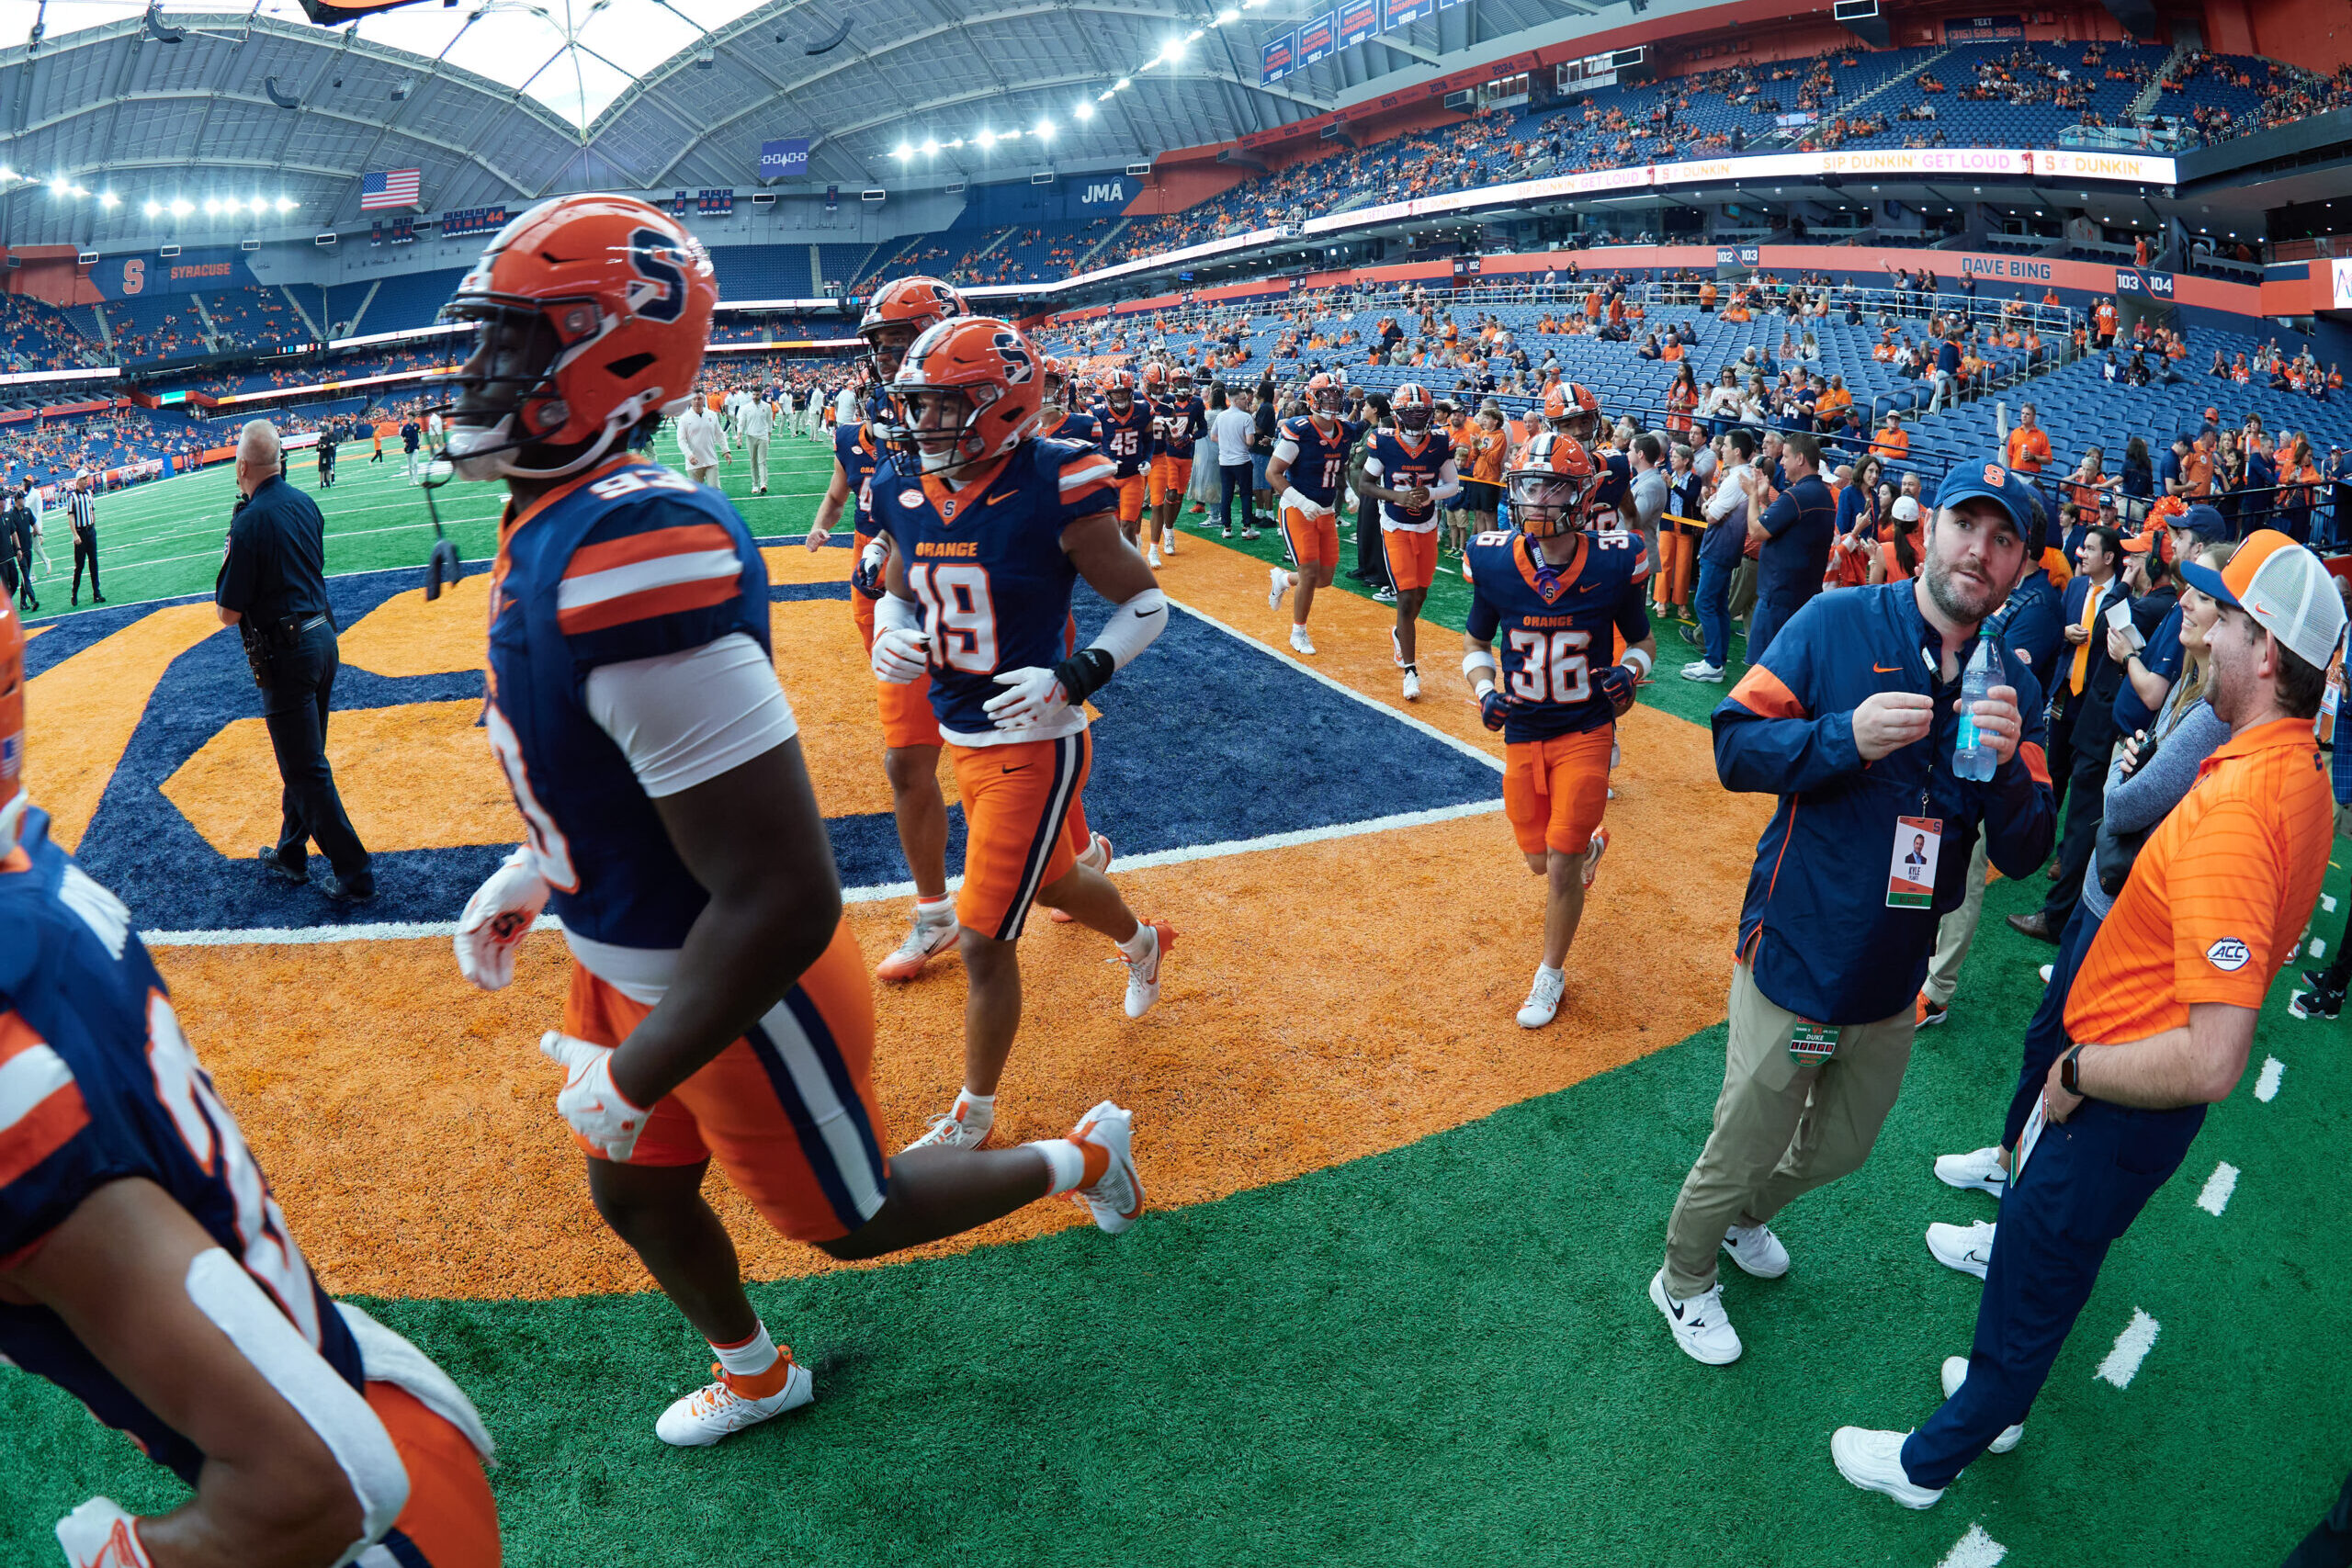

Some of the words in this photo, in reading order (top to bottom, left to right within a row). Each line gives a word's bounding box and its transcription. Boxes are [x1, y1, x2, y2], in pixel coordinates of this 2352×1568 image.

[1341, 15, 1375, 37] CHAMPIONS
[1301, 34, 1331, 55] CHAMPIONS
[1492, 62, 1515, 75] 2024
[1824, 157, 1847, 169] SIP
[1852, 155, 1917, 169] DUNKIN'
[1923, 154, 1956, 169] GET
[1962, 154, 2010, 169] LOUD
[2076, 157, 2143, 175] DUNKIN'
[1518, 185, 1532, 197] SIP
[1535, 179, 1577, 194] DUNKIN'
[1581, 176, 1602, 189] GET
[1606, 172, 1639, 186] LOUD
[1683, 164, 1732, 178] DUNKIN'
[1082, 184, 1123, 203] JMA
[487, 209, 503, 223] 44
[1367, 210, 1380, 220] GET
[1382, 206, 1403, 219] LOUD
[1717, 252, 1733, 263] 102
[1742, 250, 1758, 261] 103
[123, 259, 144, 295] S
[171, 263, 232, 279] SYRACUSE
[626, 226, 687, 323] S
[1454, 263, 1464, 274] 101
[1470, 261, 1480, 270] 102
[1962, 257, 2004, 276] DAVE
[2010, 261, 2051, 279] BING
[2117, 275, 2139, 290] 103
[2150, 277, 2172, 293] 104
[930, 285, 960, 317] S
[2100, 307, 2112, 318] 44
[992, 333, 1034, 384] S
[1782, 400, 1799, 419] 44
[1110, 431, 1138, 456] 45
[1322, 459, 1340, 488] 11
[1983, 463, 2006, 488] S
[944, 501, 956, 517] S
[915, 542, 978, 557] ORANGE
[1545, 588, 1554, 599] S
[909, 562, 1000, 675] 19
[1523, 615, 1574, 626] ORANGE
[1509, 629, 1593, 704] 36
[1933, 821, 1940, 832] S
[1908, 867, 1920, 875] KYLE
[2212, 946, 2245, 958] ACC
